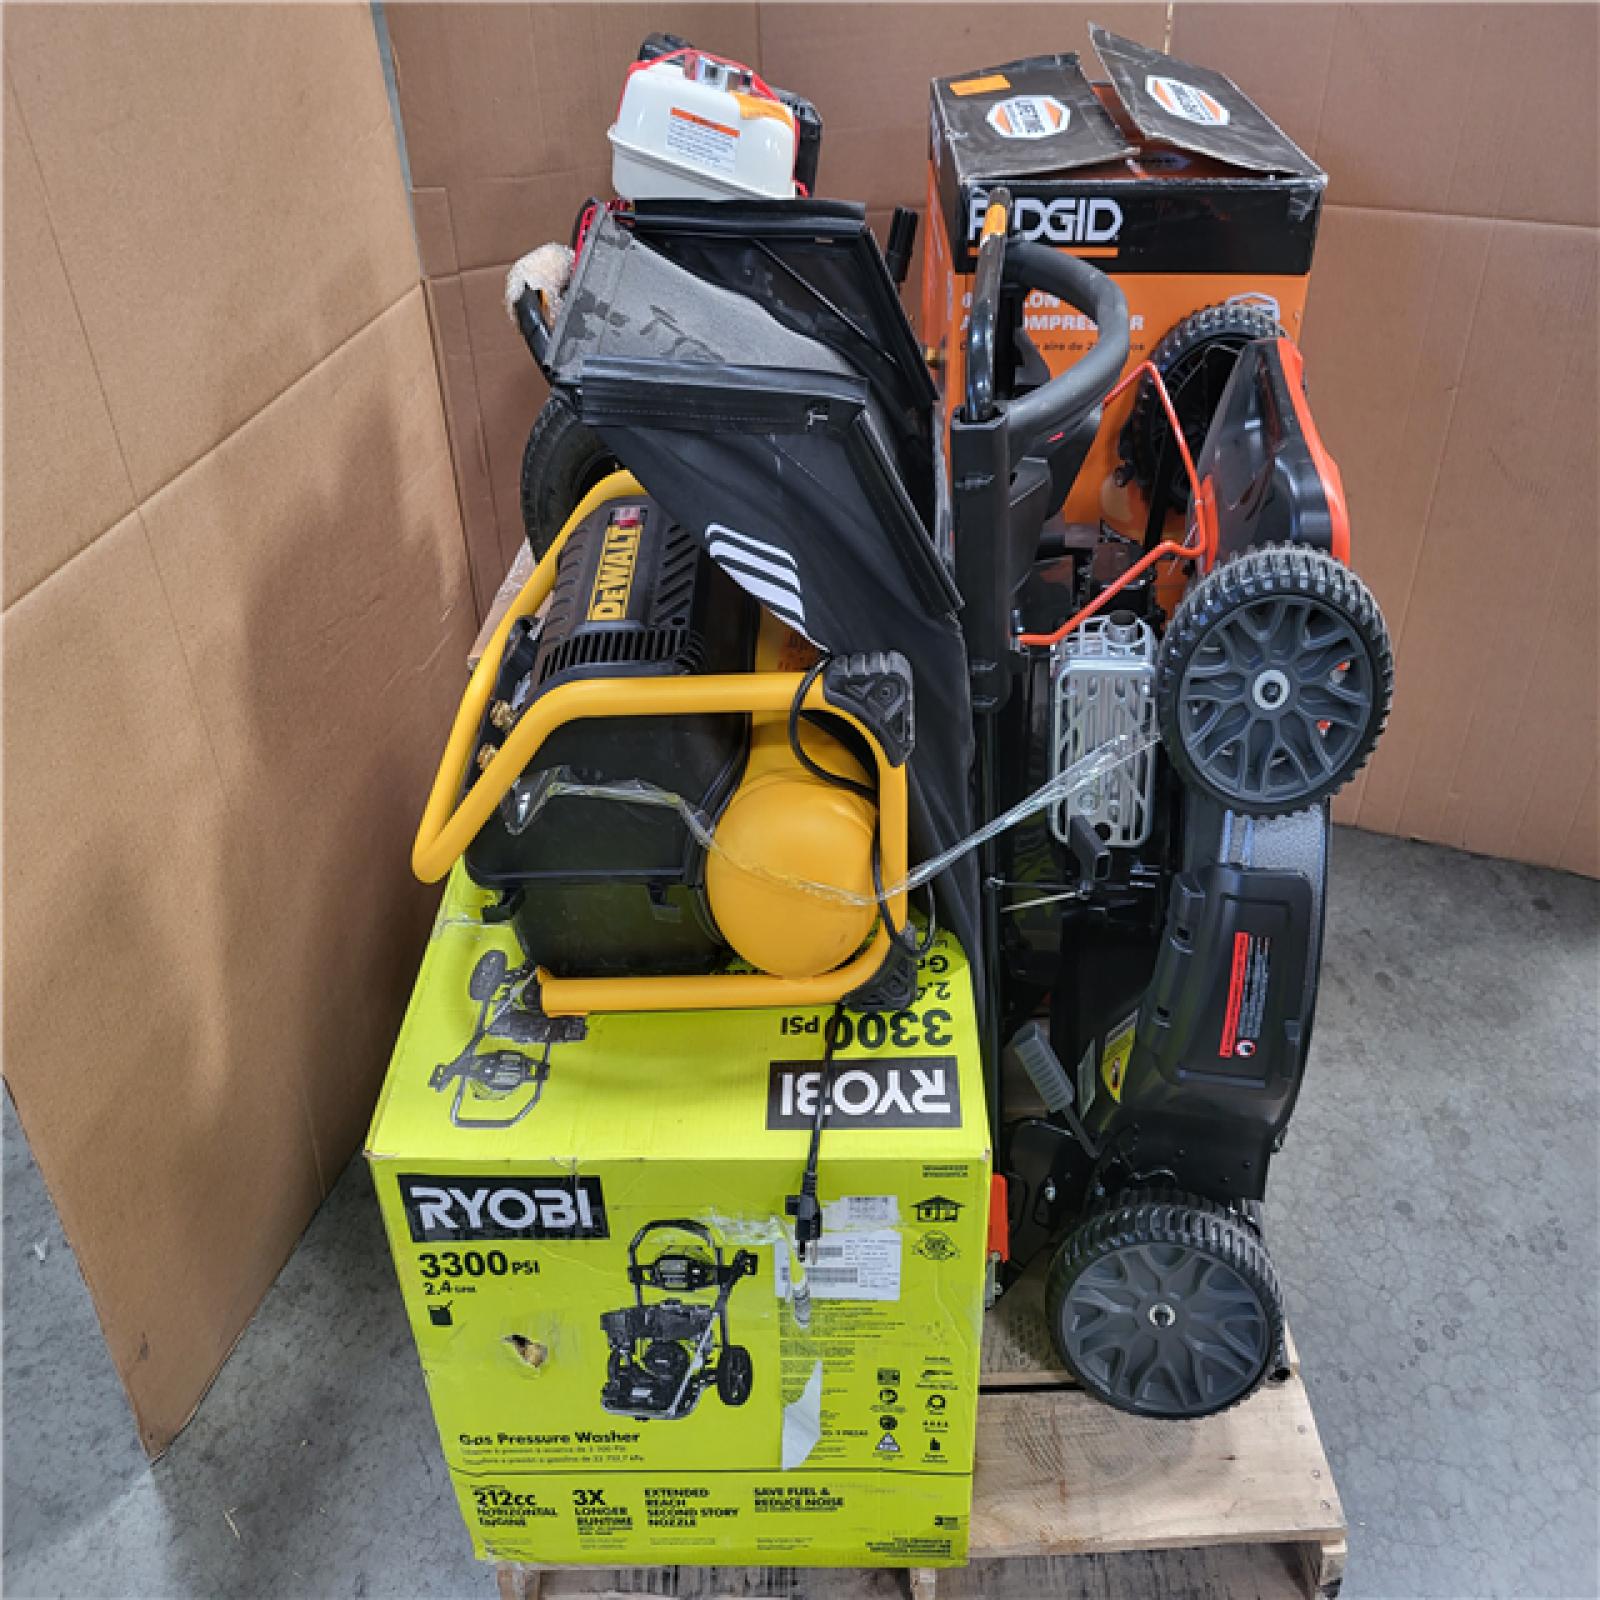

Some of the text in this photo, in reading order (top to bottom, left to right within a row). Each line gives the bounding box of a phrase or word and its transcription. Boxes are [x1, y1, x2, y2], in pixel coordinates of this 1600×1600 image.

[968, 196, 1124, 242] RDGID
[780, 1008, 953, 1050] 3300 PSI
[779, 1069, 951, 1116] RYOBI
[410, 1187, 594, 1231] RYOBI
[418, 1250, 541, 1279] 3300 PSI
[459, 1430, 641, 1447] Gas Pressure Washer
[472, 1488, 537, 1506] 212cc
[572, 1489, 606, 1506] 3X
[644, 1487, 710, 1499] EXTENDED
[700, 1507, 739, 1518] STORY
